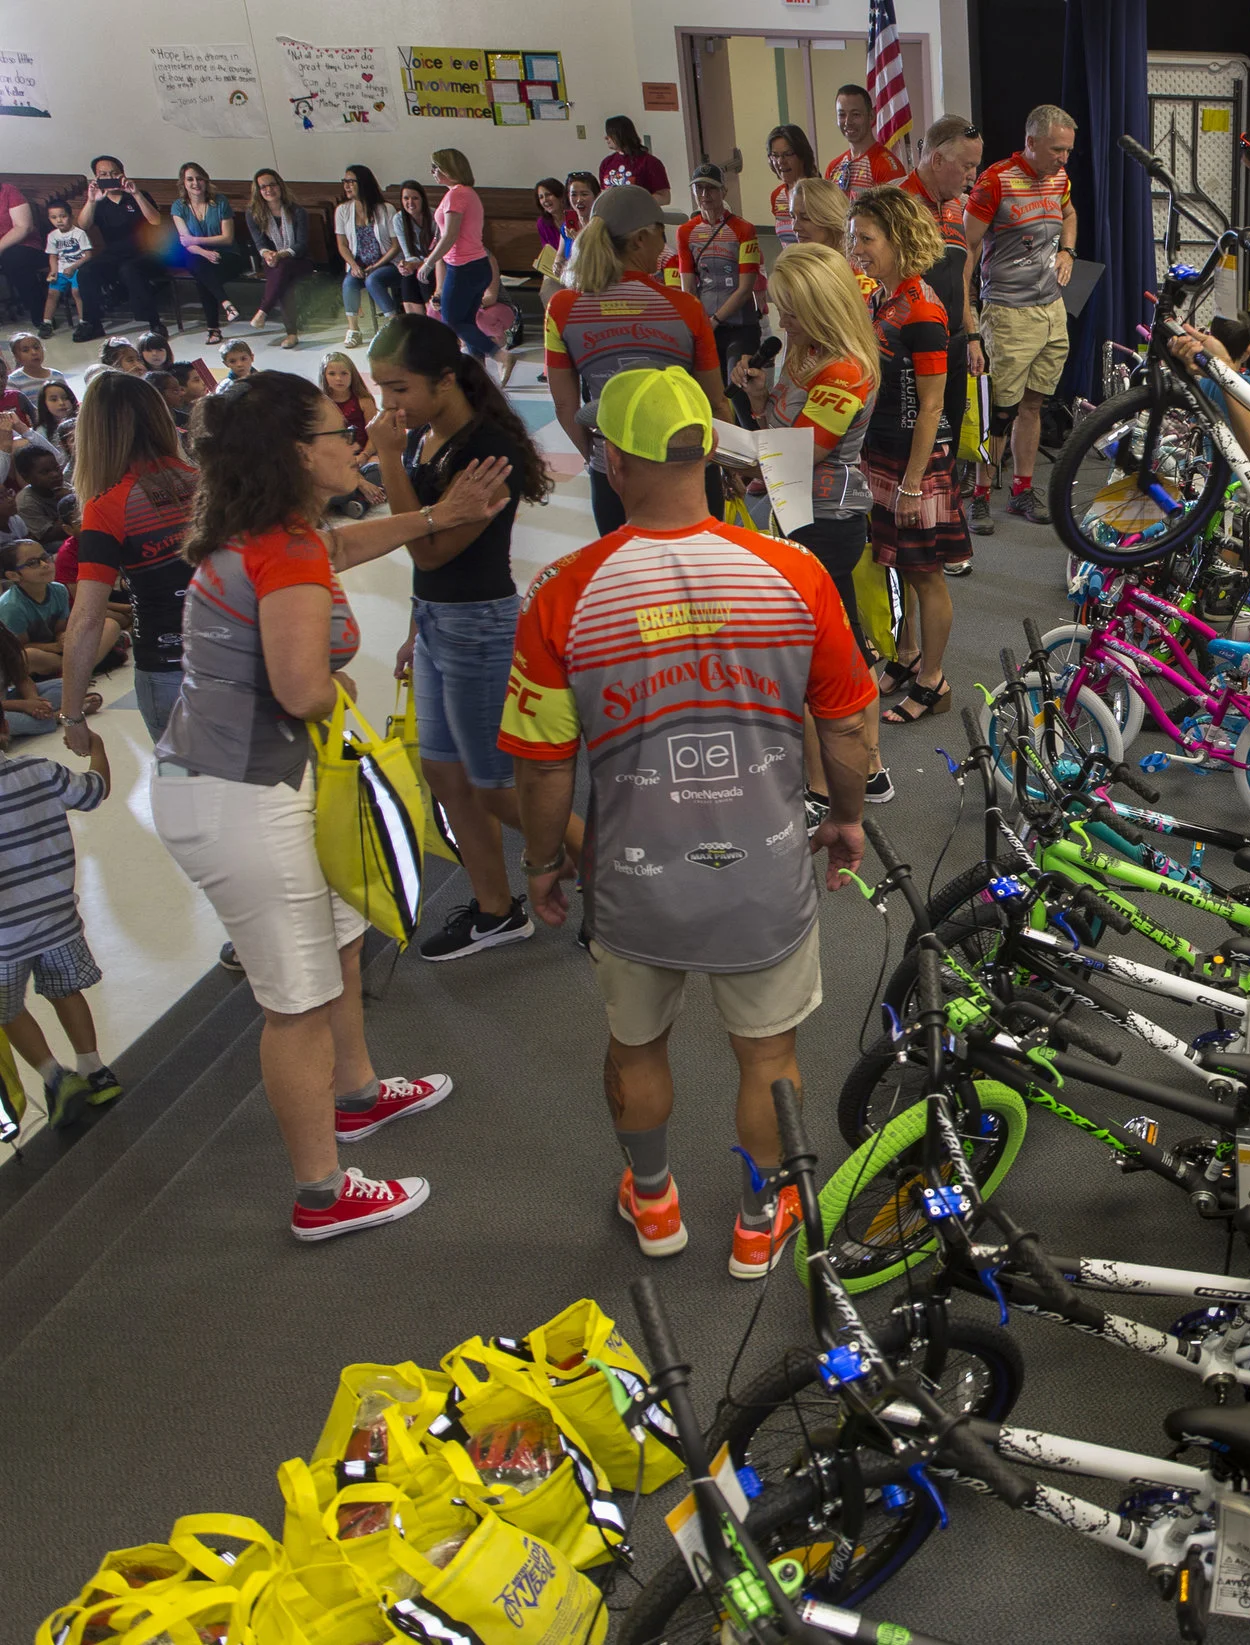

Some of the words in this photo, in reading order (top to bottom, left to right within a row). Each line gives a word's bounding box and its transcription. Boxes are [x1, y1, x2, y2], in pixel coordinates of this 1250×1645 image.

[361, 52, 372, 60] do
[397, 46, 443, 69] Voice
[449, 56, 483, 71] level
[298, 63, 321, 77] great
[303, 79, 319, 87] can
[325, 77, 337, 88] do
[405, 91, 493, 118] Performance
[810, 389, 852, 415] UFC
[906, 368, 918, 429] LAURICH
[635, 600, 734, 630] BREAKAWAY
[508, 674, 543, 718] FC
[681, 786, 744, 800] OneNevada
[634, 863, 664, 876] Coffee
[1199, 997, 1243, 1015] KENT
